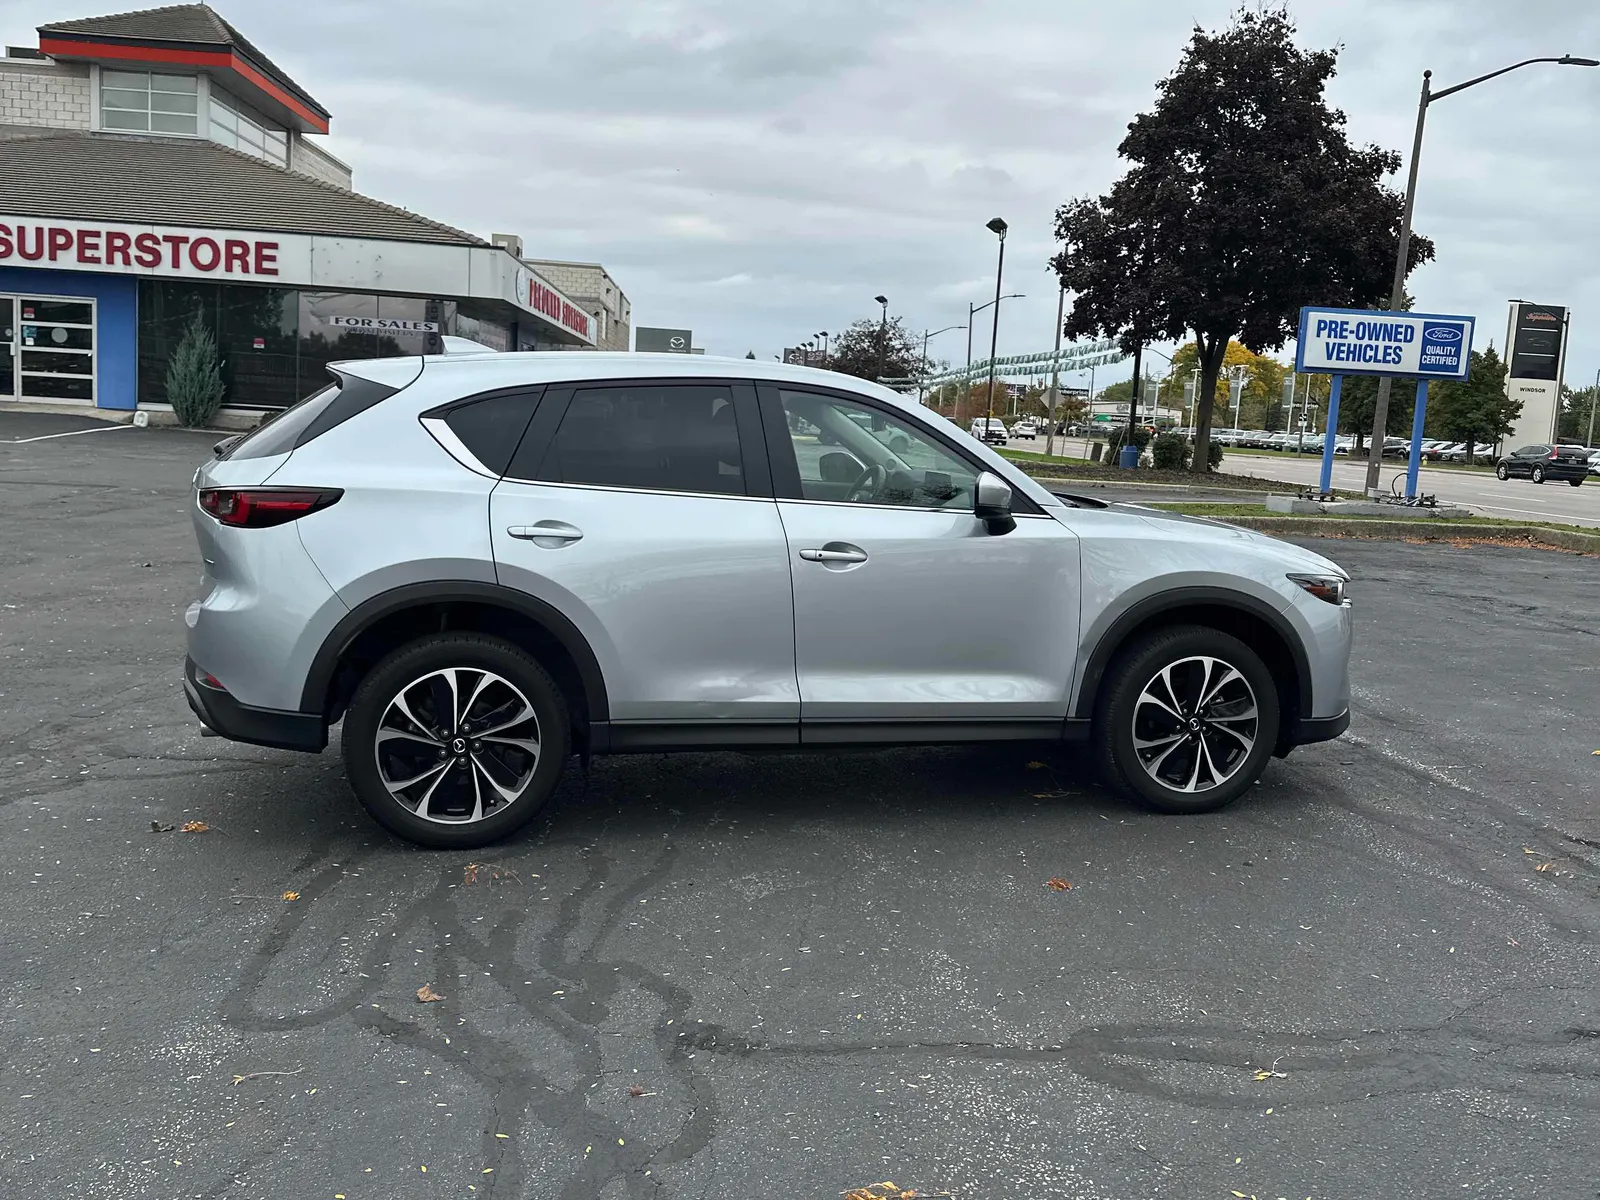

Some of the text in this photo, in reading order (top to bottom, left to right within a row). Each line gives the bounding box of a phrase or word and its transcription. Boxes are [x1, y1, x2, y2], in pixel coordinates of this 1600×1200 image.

[334, 317, 434, 331] FOR SALES
[1316, 319, 1414, 343] PRE-OWNED
[1430, 329, 1456, 340] Ford
[1325, 342, 1403, 365] VEHICLES
[1426, 345, 1456, 355] QUALITY
[1421, 355, 1458, 366] CERTIFIED
